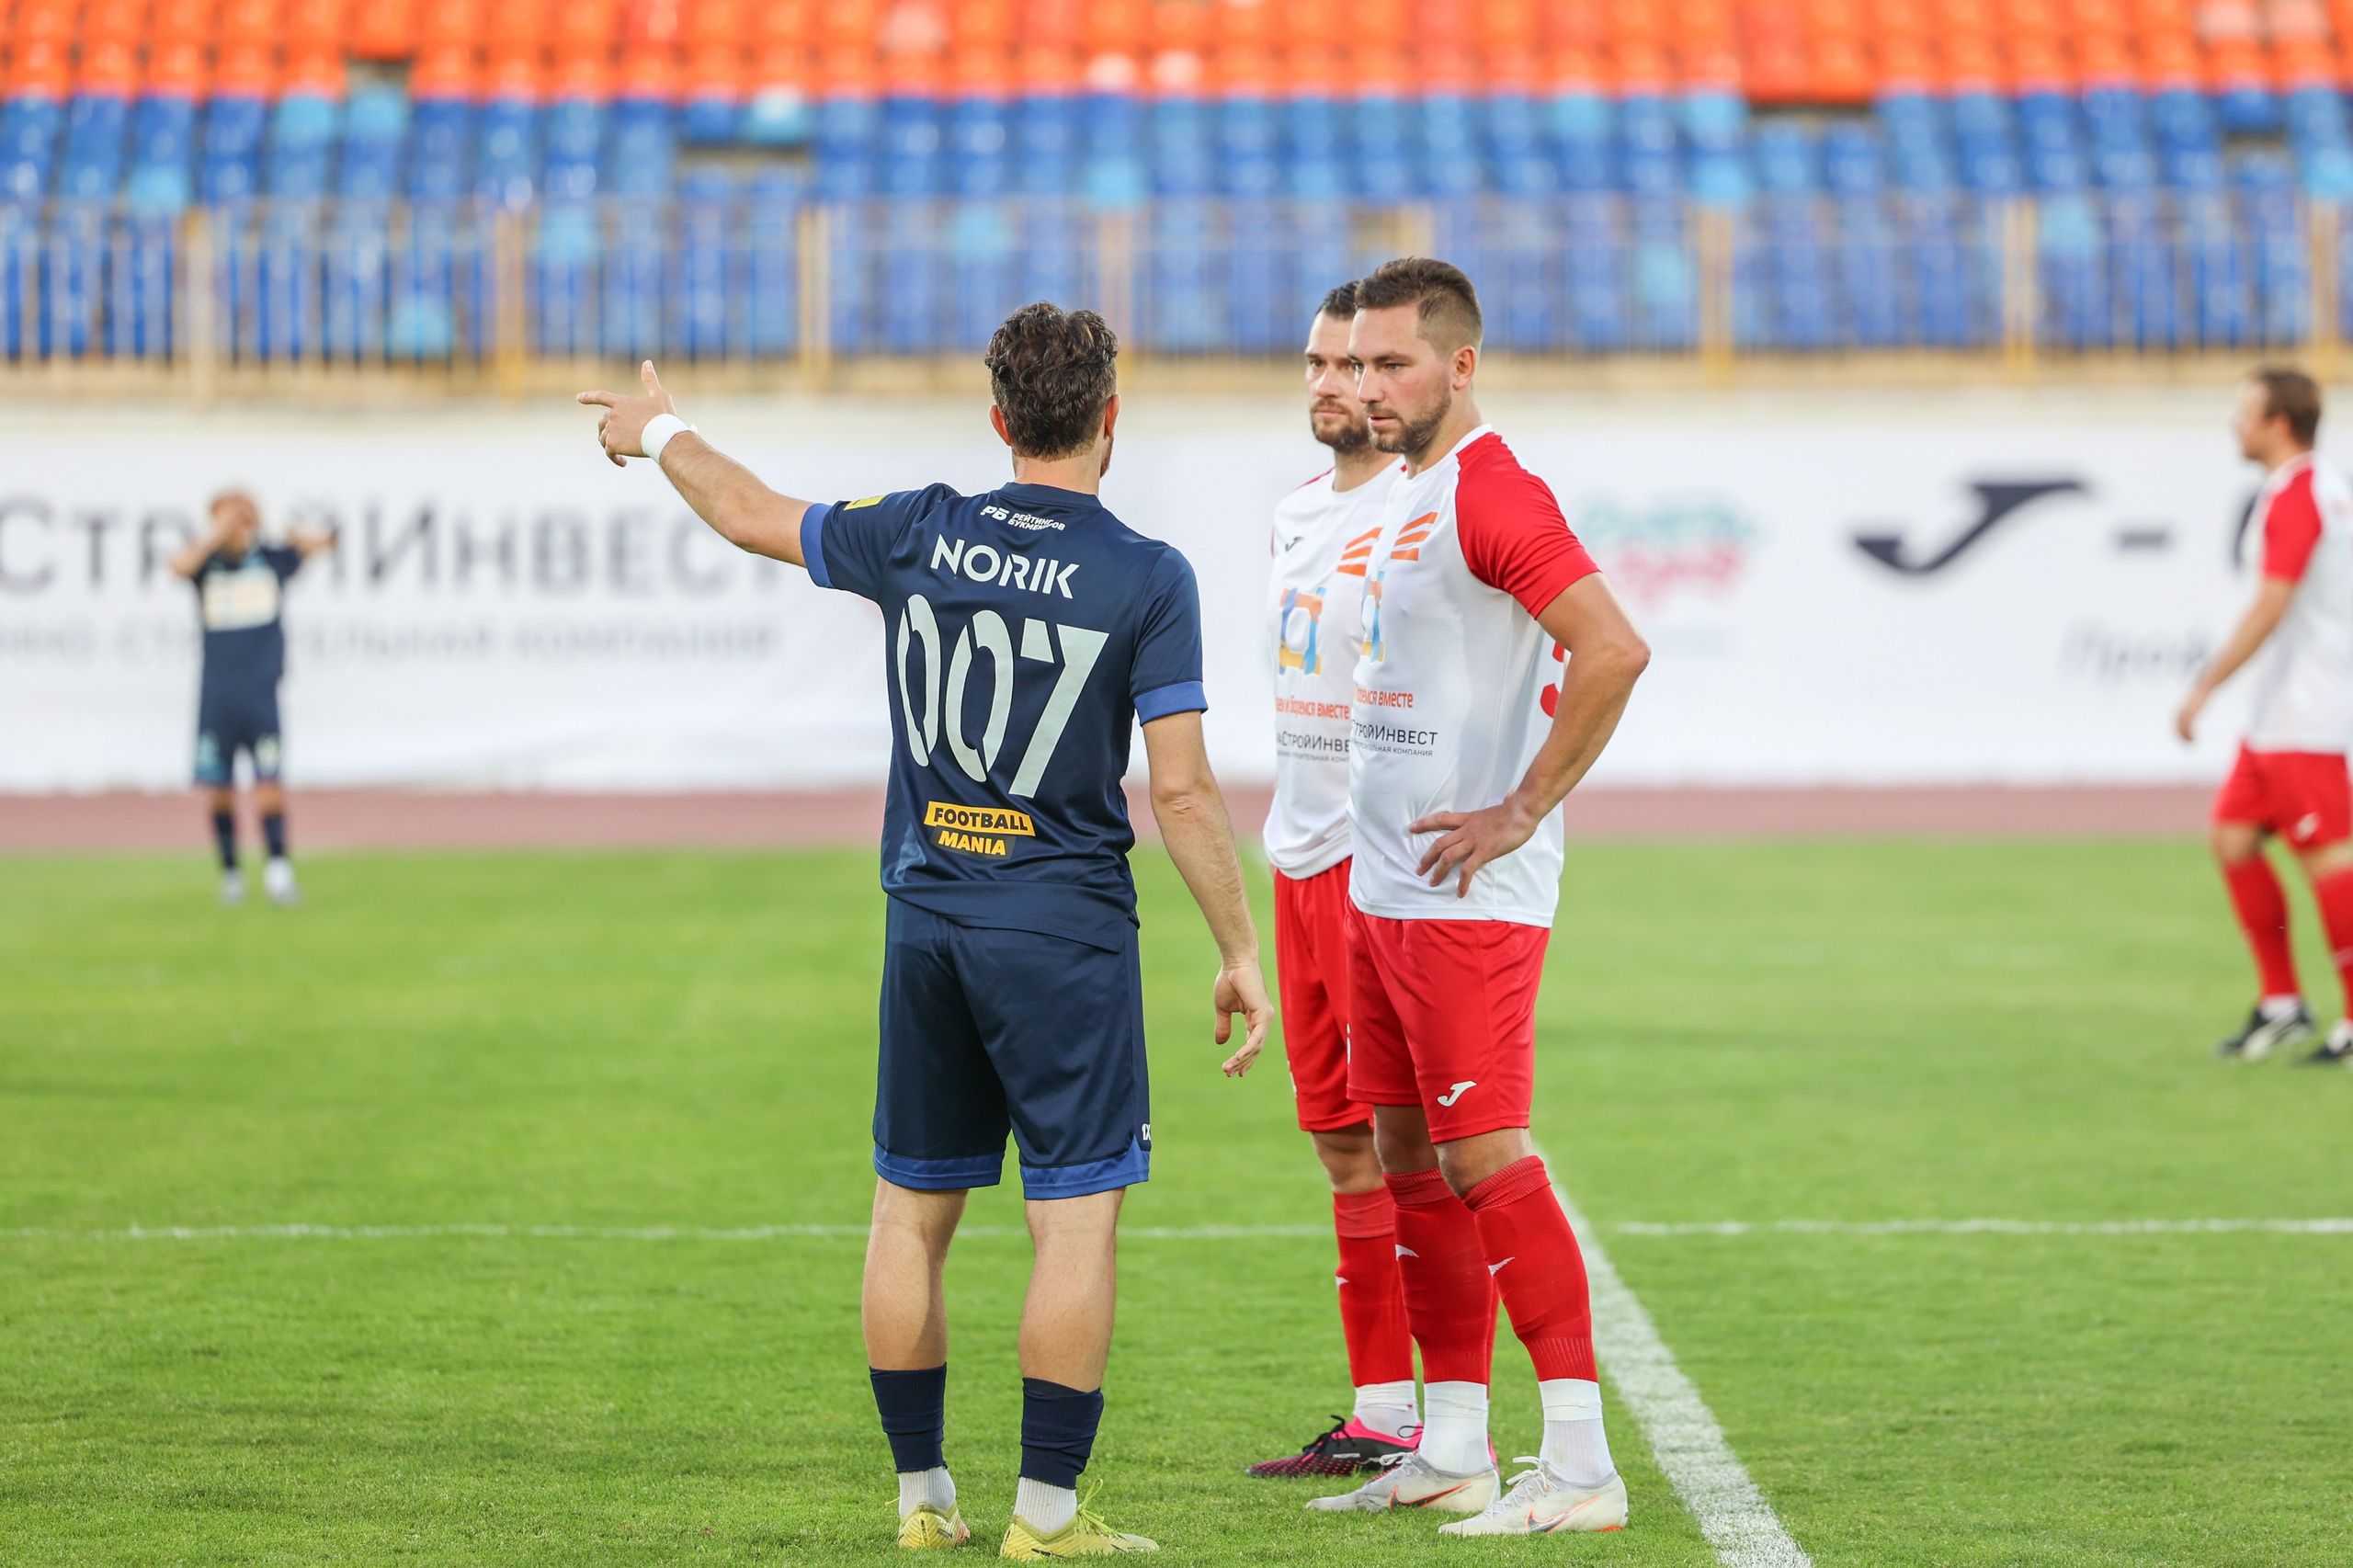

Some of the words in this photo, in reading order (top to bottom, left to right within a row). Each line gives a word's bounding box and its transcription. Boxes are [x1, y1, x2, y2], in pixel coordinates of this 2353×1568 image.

[930, 534, 1080, 599] NORIK
[896, 594, 1110, 799] 007
[1379, 691, 1414, 709] вместе
[1317, 702, 1349, 720] вместе
[1392, 746, 1433, 756] КОМПАНИЯ
[934, 807, 1029, 831] FOOTBALL
[938, 830, 1006, 856] MANIA
